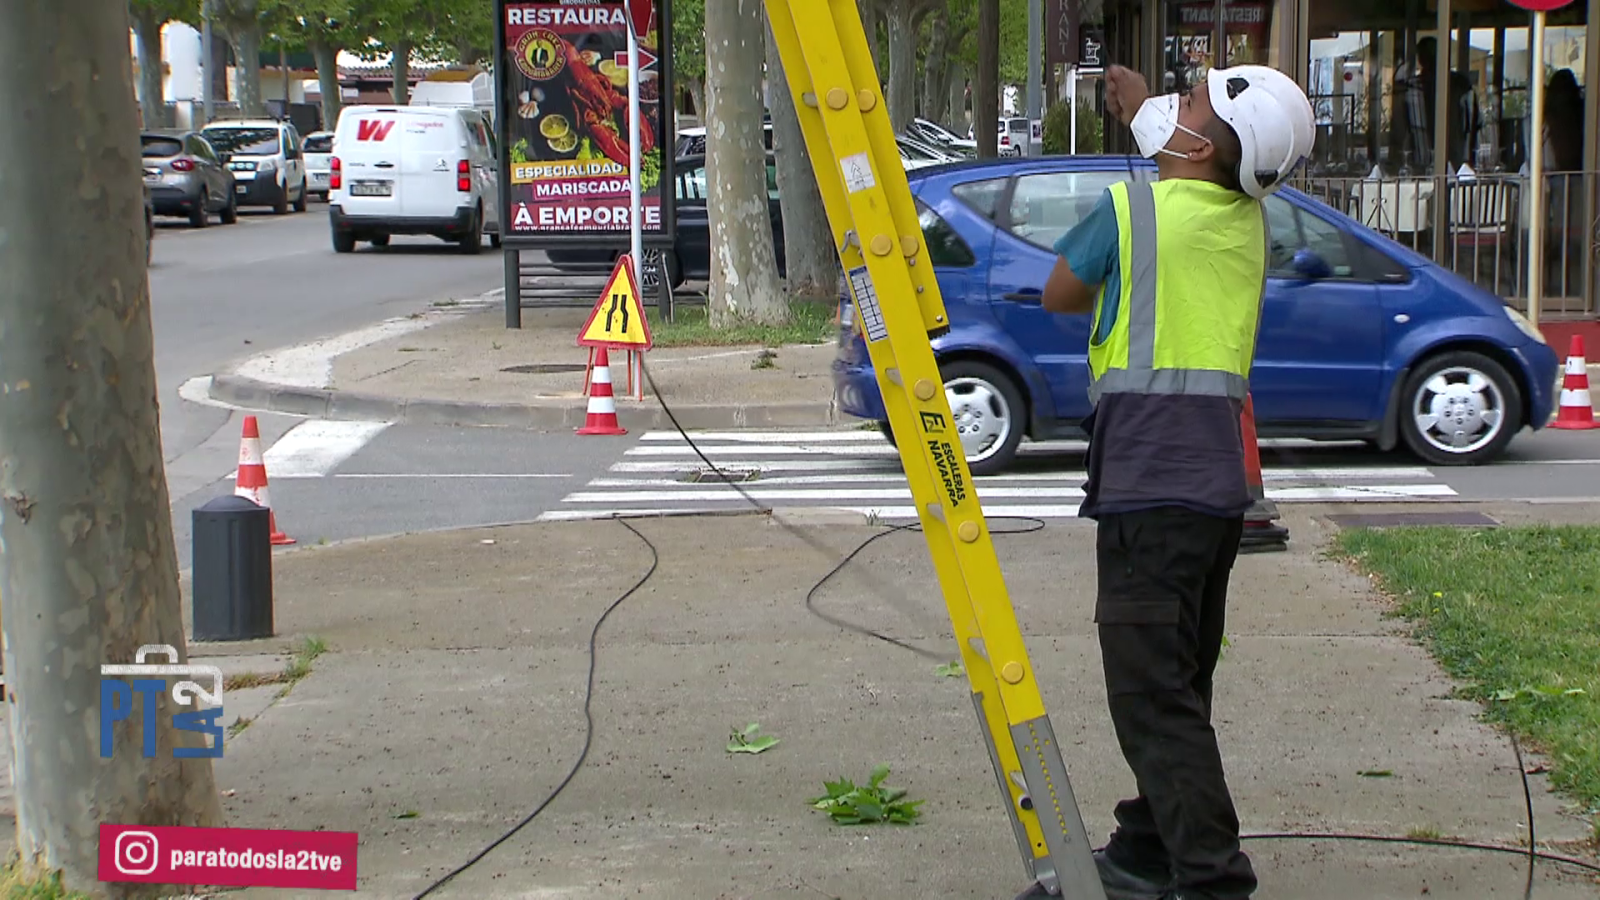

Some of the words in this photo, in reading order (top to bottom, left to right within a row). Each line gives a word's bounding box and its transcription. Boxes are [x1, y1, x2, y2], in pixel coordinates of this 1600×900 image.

[508, 8, 655, 25] RESTAURA
[515, 162, 623, 179] ESPECIALIDAD
[537, 179, 631, 197] MARISCADA
[514, 201, 533, 225] À
[927, 440, 959, 508] NAVARRA
[941, 442, 966, 501] ESCALERAS
